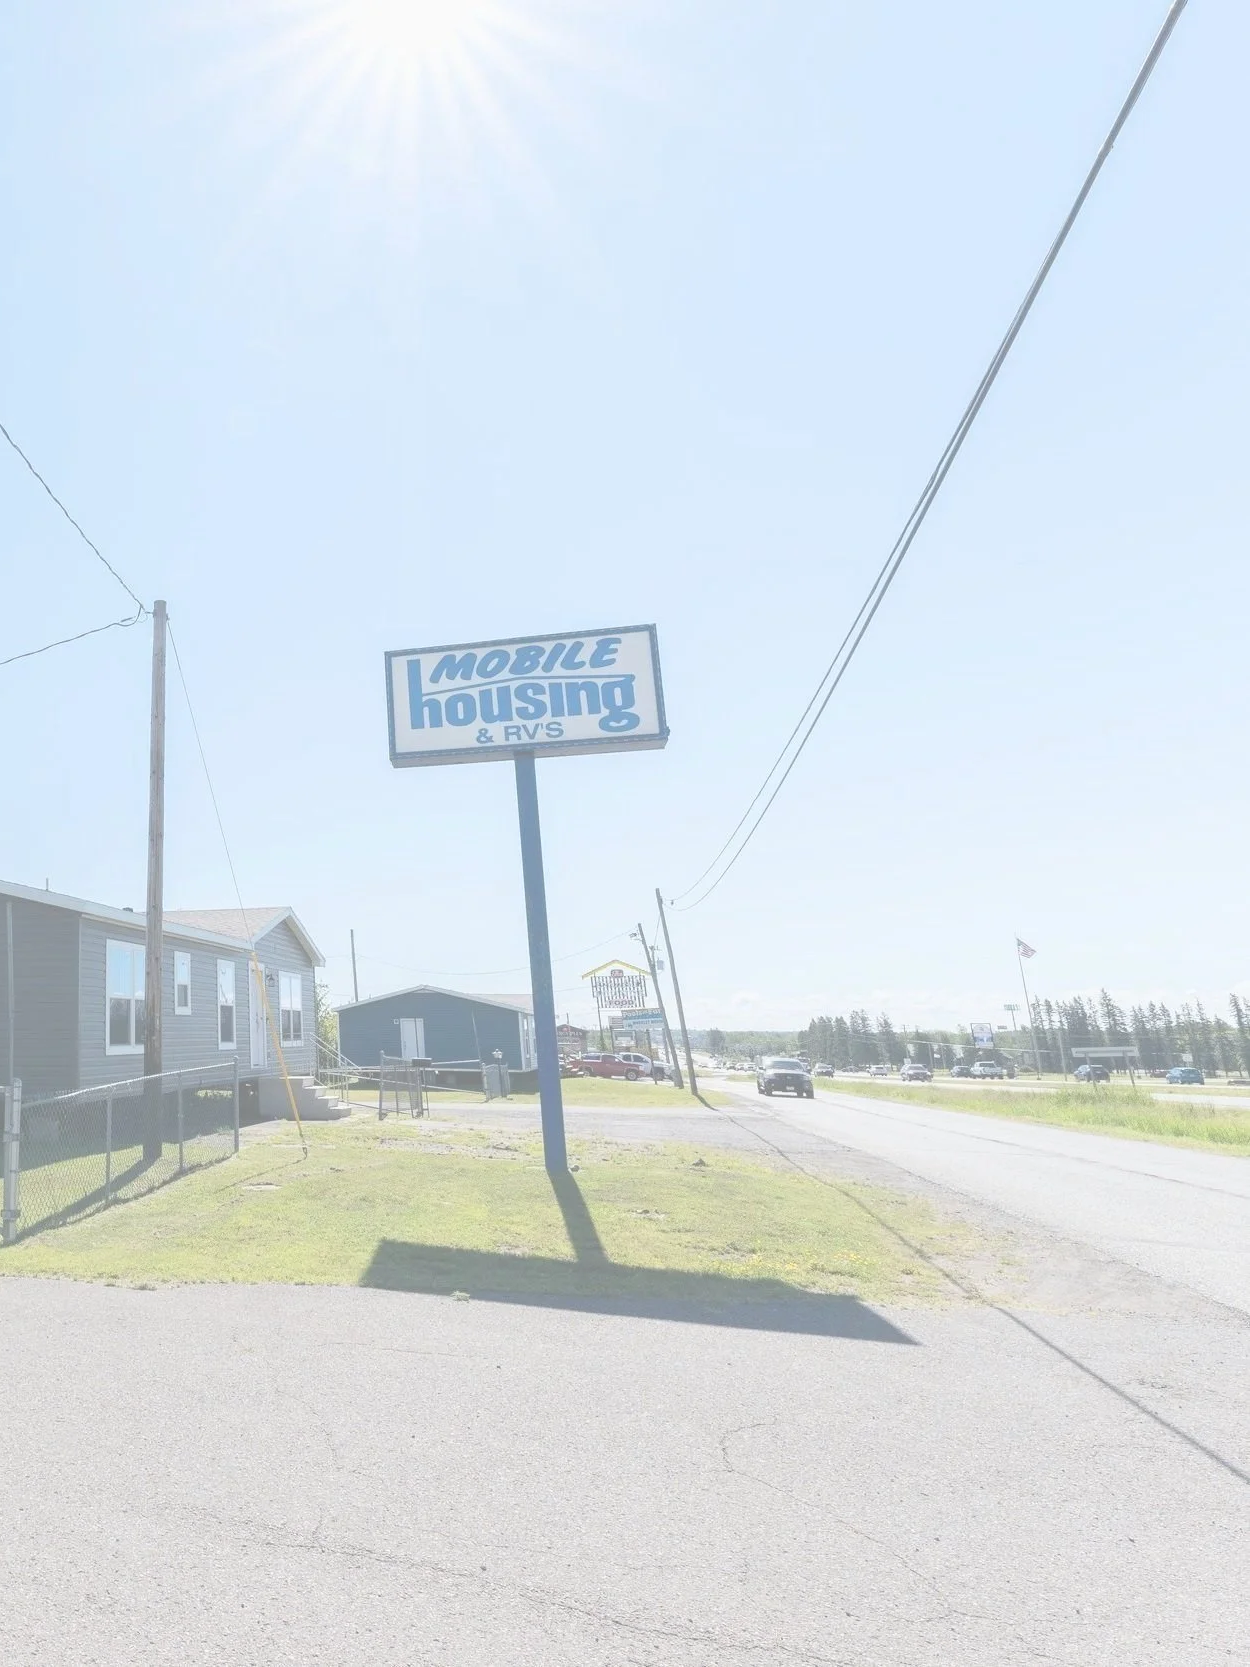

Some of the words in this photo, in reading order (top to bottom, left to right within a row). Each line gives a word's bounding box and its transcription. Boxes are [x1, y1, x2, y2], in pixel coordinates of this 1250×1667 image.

[428, 637, 622, 684] MOBILE
[406, 658, 640, 733] housing
[475, 728, 494, 744] &
[503, 721, 565, 742] RV'S
